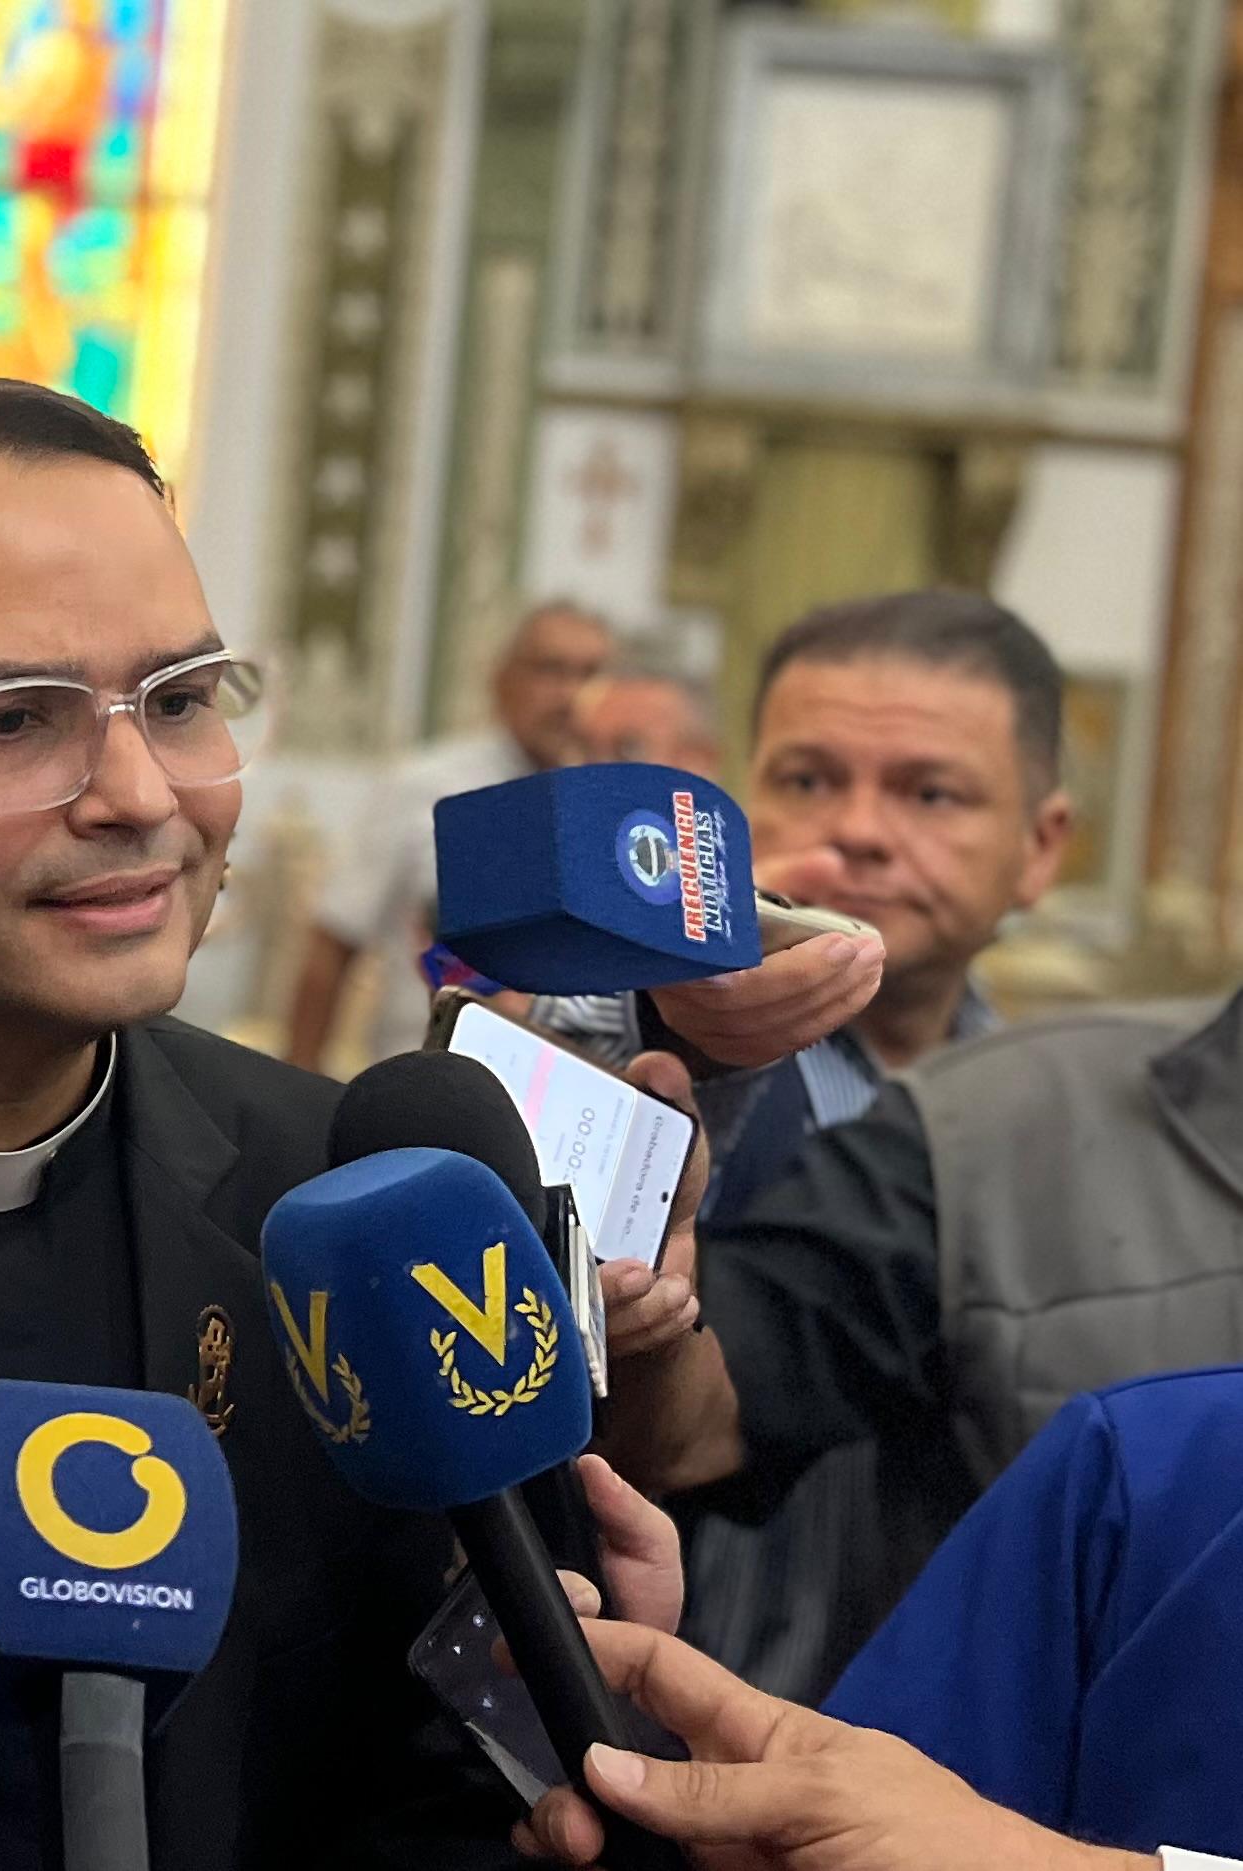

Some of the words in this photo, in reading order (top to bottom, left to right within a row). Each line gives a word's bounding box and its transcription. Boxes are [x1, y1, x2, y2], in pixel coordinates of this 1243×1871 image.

[673, 792, 707, 942] FRECUENCIA
[695, 811, 723, 931] NOTICIAS
[19, 1576, 195, 1611] GLOBOVISION
